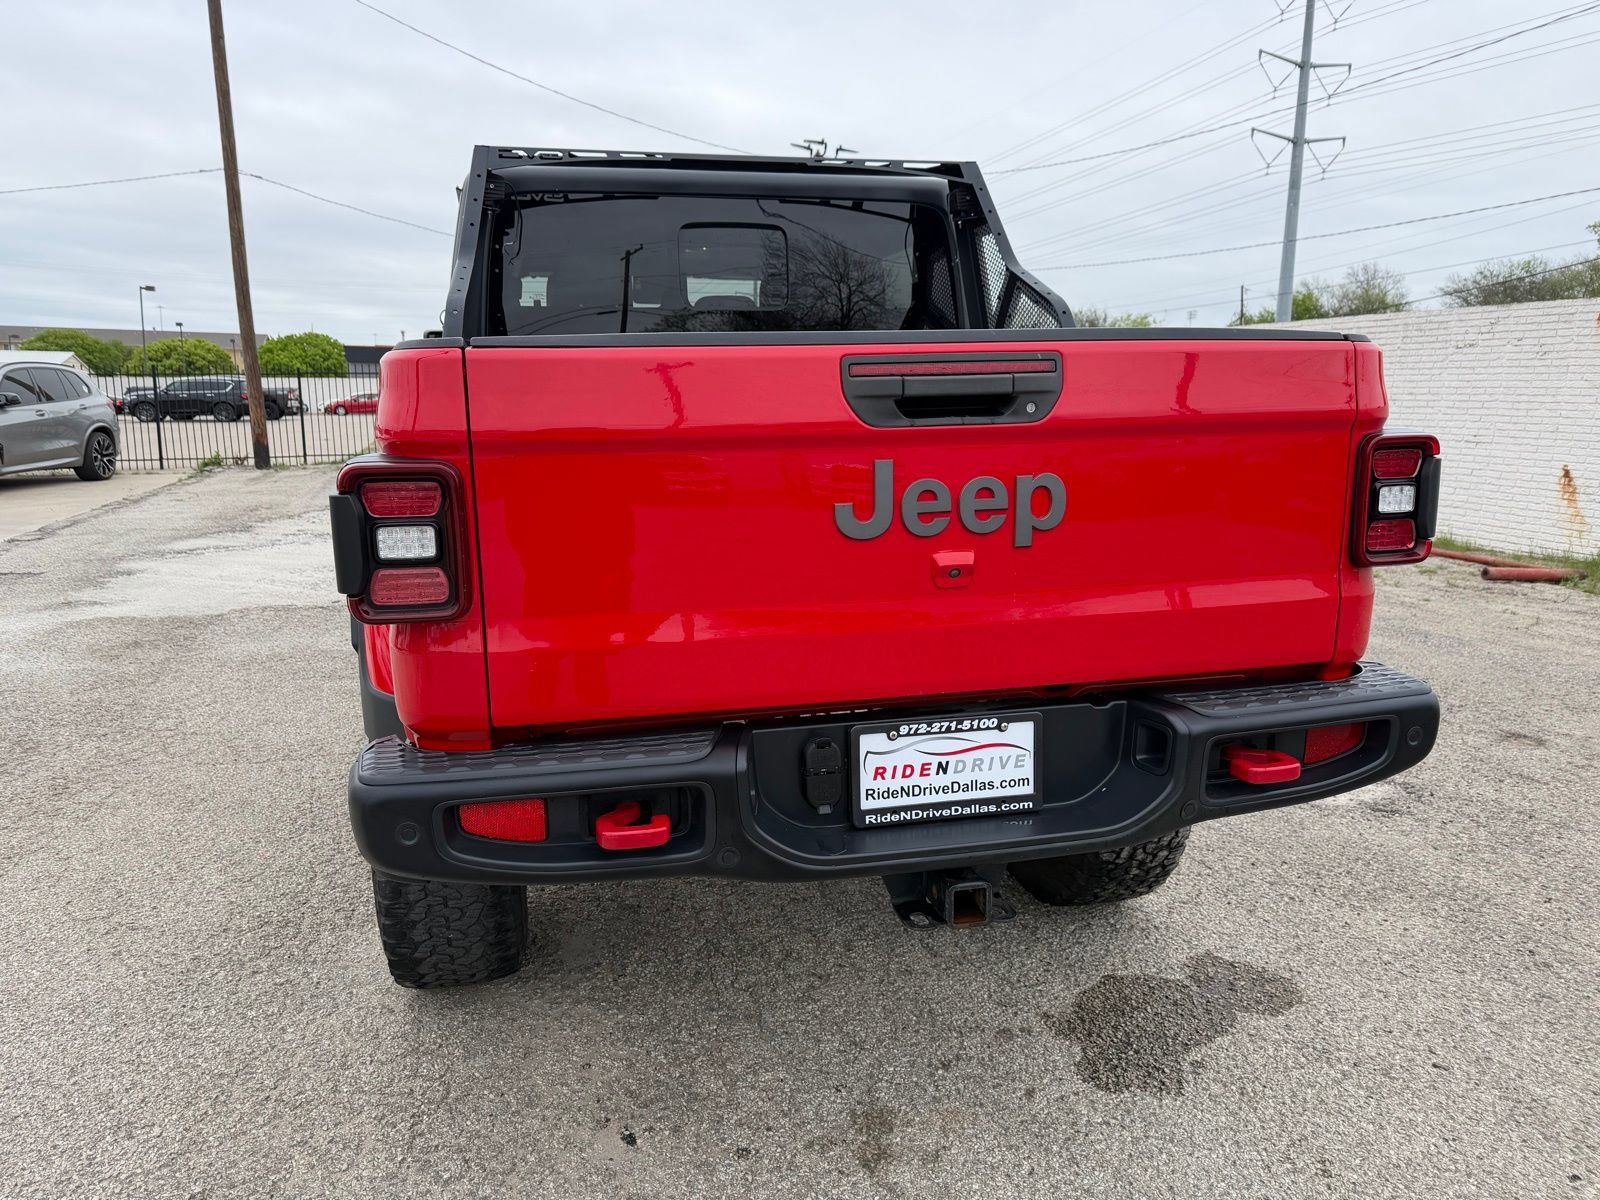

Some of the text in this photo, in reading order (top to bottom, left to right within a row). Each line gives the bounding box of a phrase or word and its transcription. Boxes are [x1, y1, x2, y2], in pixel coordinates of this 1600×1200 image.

[833, 459, 1067, 547] Jeep
[899, 718, 998, 735] 972-271-5100
[865, 777, 1030, 801] RideNDriveDallas.com
[865, 801, 1033, 825] RideNDriveDallas.com
